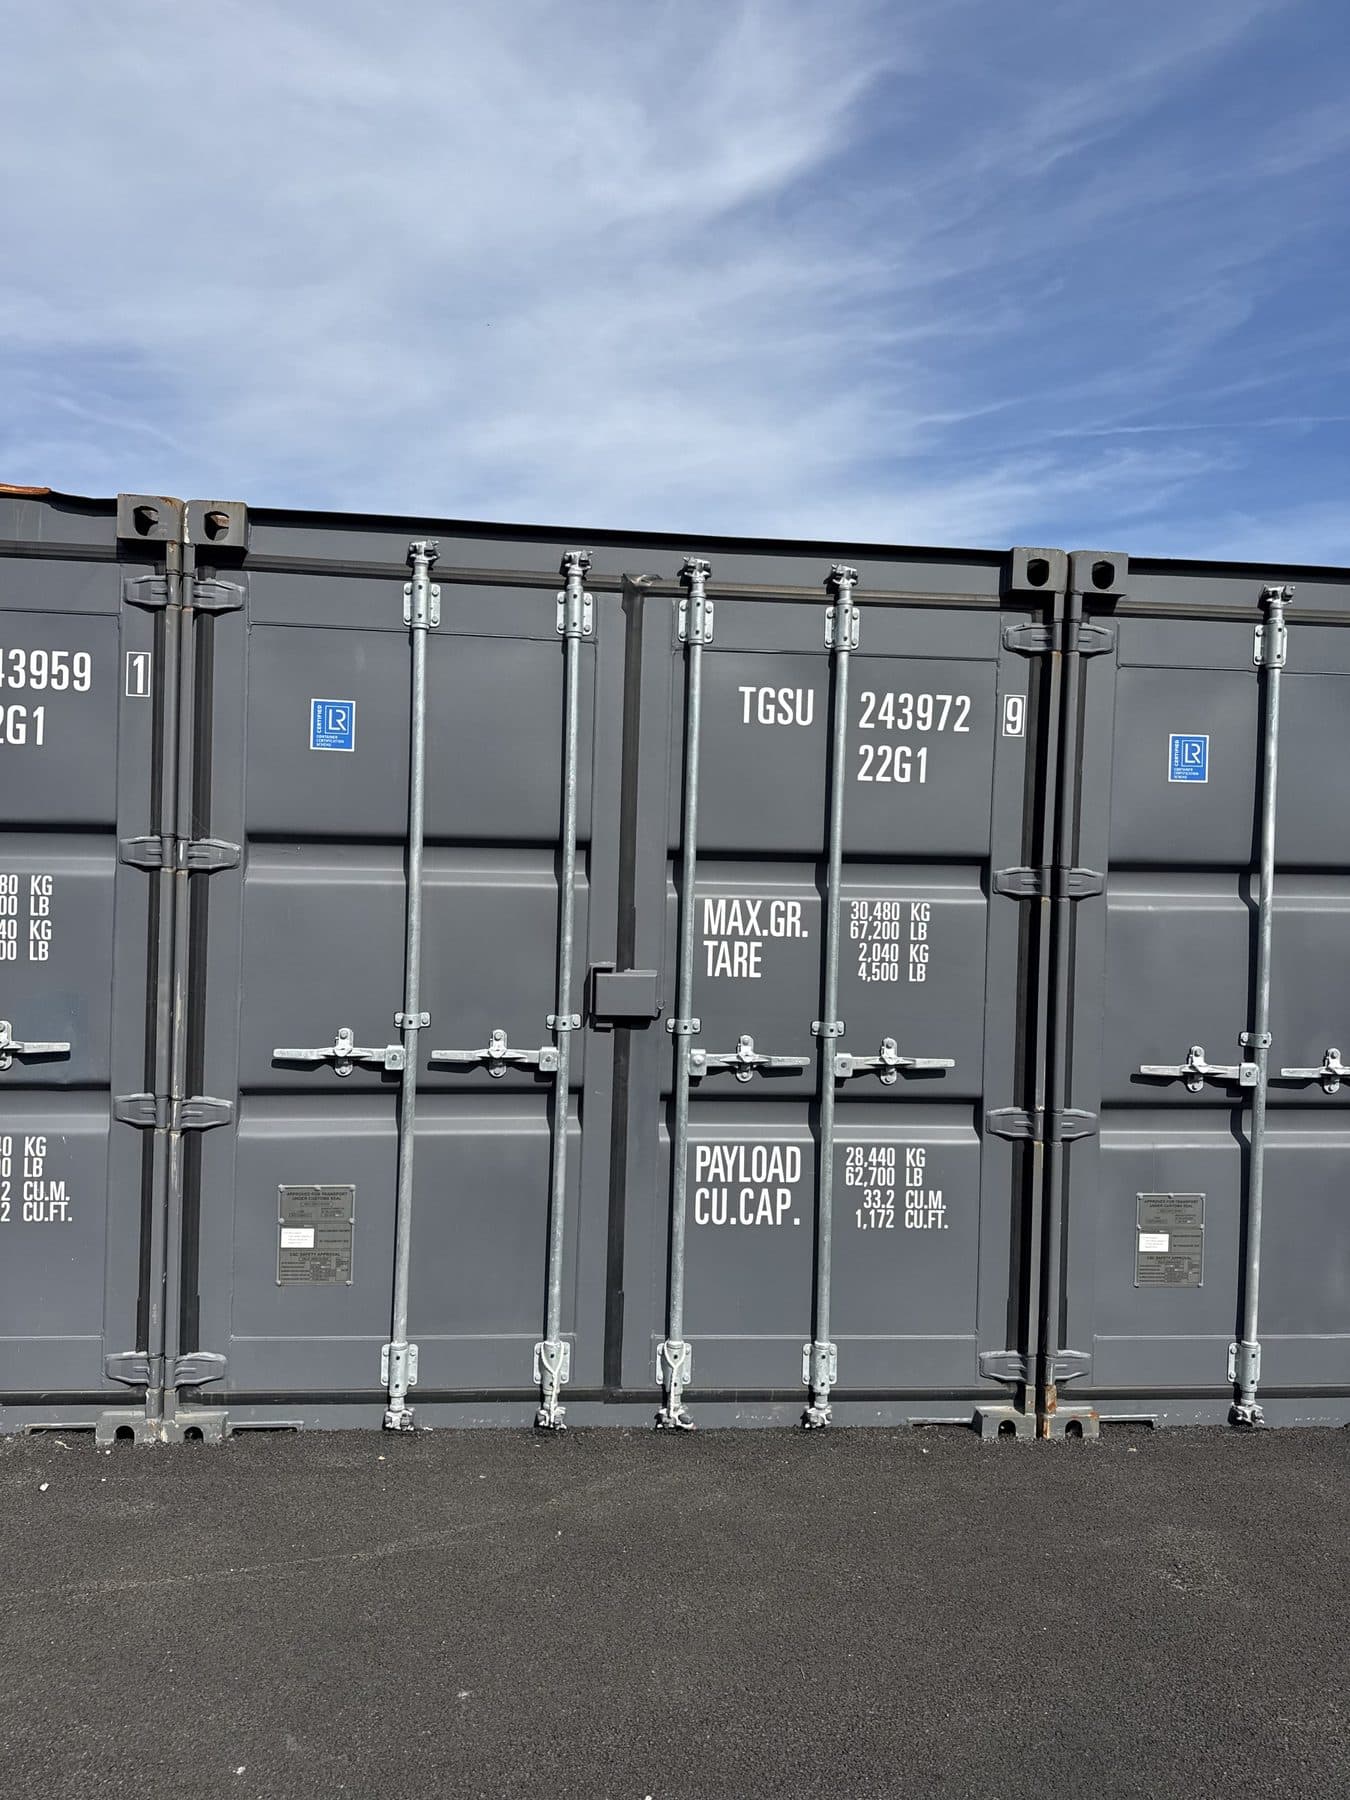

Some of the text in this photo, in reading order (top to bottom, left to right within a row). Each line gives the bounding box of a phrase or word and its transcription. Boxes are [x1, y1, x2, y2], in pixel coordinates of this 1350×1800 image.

[0, 648, 145, 694] 3959 1
[328, 709, 347, 731] LR
[738, 686, 1023, 734] TGSU 243972 9
[0, 704, 45, 746] G1
[1184, 743, 1201, 764] LR
[857, 745, 928, 784] 22G1
[30, 875, 53, 896] KG
[30, 896, 50, 916] LB
[850, 901, 930, 922] 30,480 KG
[703, 899, 809, 938] MAX.GR.
[29, 920, 52, 940] KG
[850, 921, 927, 941] 67,200 LB
[29, 941, 49, 961] LB
[703, 940, 763, 978] TARE
[858, 943, 929, 963] 2,040 KG
[857, 962, 926, 982] 4,500 LB
[24, 1136, 47, 1157] KG
[846, 1146, 926, 1168] 28,440 KG
[23, 1157, 43, 1178] LB
[696, 1145, 801, 1183] PAYLOAD
[845, 1167, 923, 1187] 62,700 LB
[23, 1181, 71, 1201] CU.M.
[863, 1189, 947, 1209] 33.2 CU.M.
[23, 1202, 73, 1222] CU.FT.
[695, 1187, 800, 1225] CU.CAP.
[855, 1209, 949, 1230] 1,172 CU.FT.
